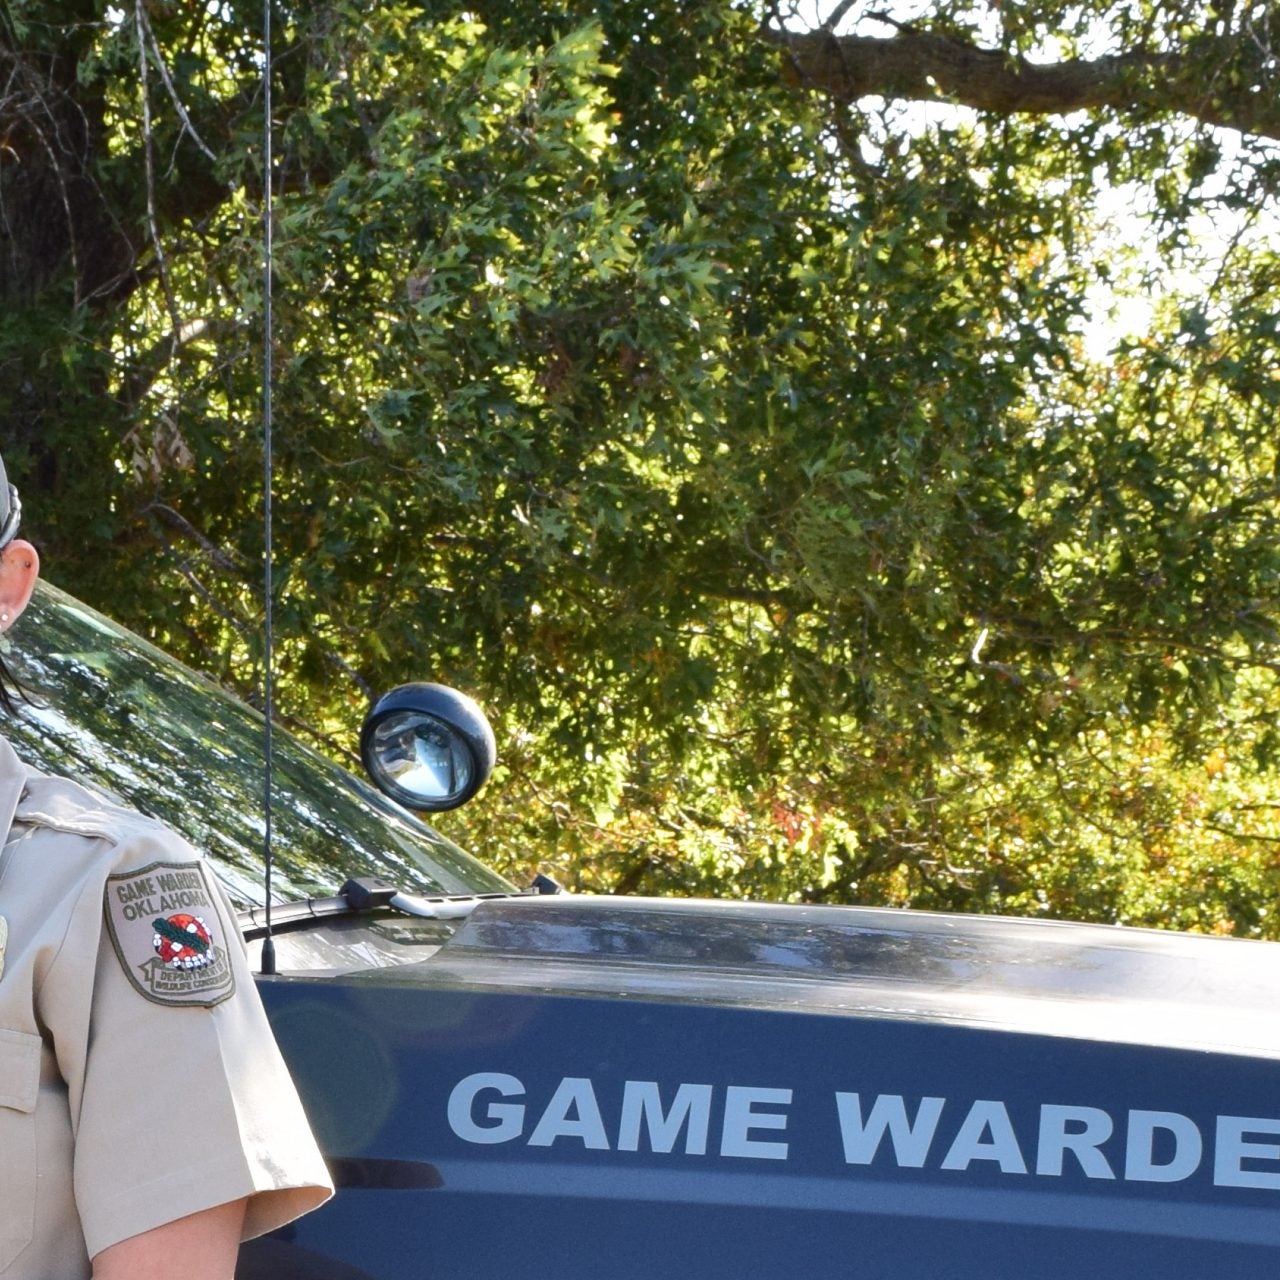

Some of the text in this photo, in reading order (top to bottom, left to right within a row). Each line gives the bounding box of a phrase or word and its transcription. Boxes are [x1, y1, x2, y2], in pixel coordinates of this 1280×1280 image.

[116, 876, 158, 903] GAME
[122, 891, 211, 921] OKLAHOMA
[446, 1071, 794, 1161] GAME
